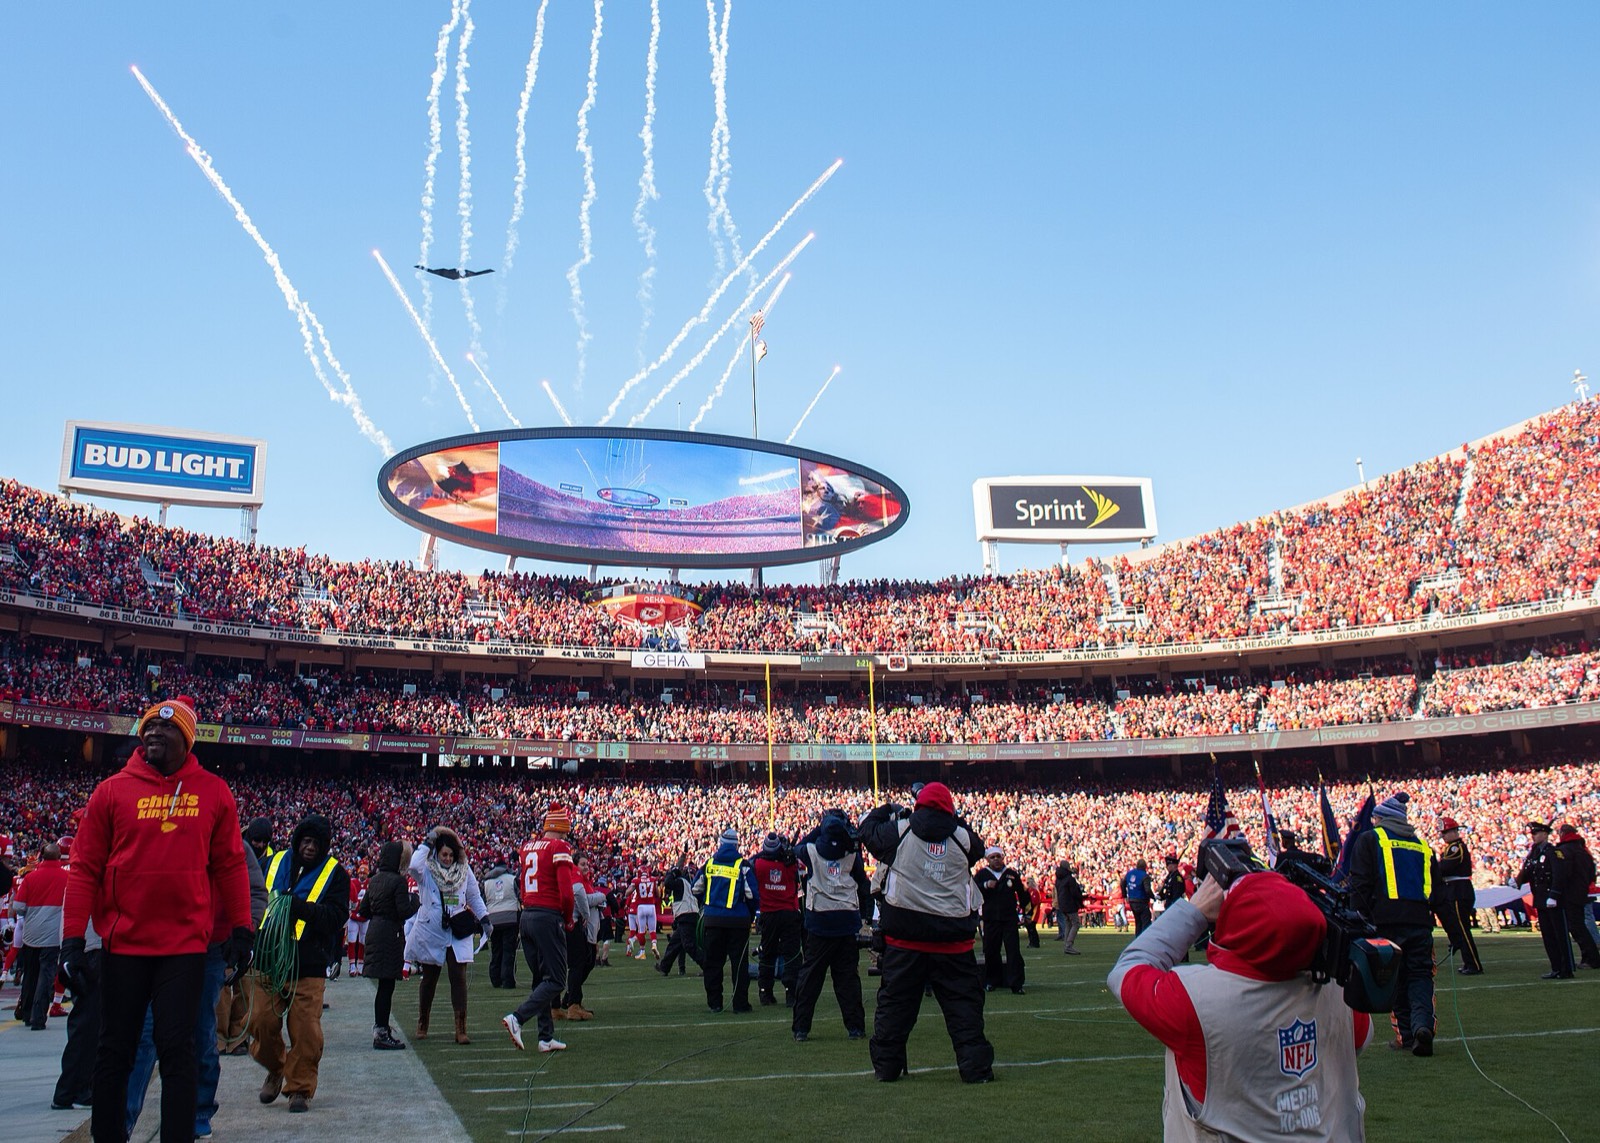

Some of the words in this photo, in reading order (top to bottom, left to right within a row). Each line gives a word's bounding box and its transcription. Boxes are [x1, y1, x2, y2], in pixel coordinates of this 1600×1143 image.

[84, 443, 151, 470] BUD
[1015, 499, 1086, 526] Sprint
[644, 596, 666, 604] GEHA
[35, 600, 44, 608] 78
[47, 601, 55, 610] B.
[57, 603, 80, 614] BELL
[1522, 604, 1565, 616] CHERRY
[112, 611, 120, 620] B.
[122, 613, 174, 628] BUCHANAN
[1420, 617, 1477, 631] McCLINTON
[216, 626, 250, 636] TAYLOR
[1337, 630, 1375, 640] RUDNAY
[288, 633, 320, 642] BUDDE
[1245, 638, 1293, 648] HEADRICK
[361, 639, 395, 648] LANIER
[432, 644, 470, 653] THOMAS
[487, 646, 512, 654] HANK
[514, 648, 544, 656] STRAM
[582, 650, 615, 659] WILSON
[1084, 651, 1119, 660] HAYNES
[1154, 645, 1202, 656] STENERUD
[644, 654, 690, 666] GEHA
[856, 660, 869, 668] 2:21
[940, 656, 980, 664] PODOLAK
[1016, 655, 1044, 663] LYNCH
[16, 708, 61, 716] AVAILABLE
[1414, 719, 1476, 735] 2020
[1483, 708, 1569, 728] CHIEFS
[227, 727, 240, 735] KC
[272, 730, 292, 738] 0:00
[1311, 729, 1379, 742] ARROWHEAD
[272, 738, 292, 746] 0:00
[690, 746, 728, 759] 2:21
[137, 808, 199, 821] kingdom
[929, 844, 945, 855] NFL
[924, 860, 946, 872] MEDIA
[525, 852, 538, 892] 2
[638, 882, 653, 898] 87
[1284, 1042, 1314, 1070] NFL
[1276, 1084, 1318, 1113] MEDIA
